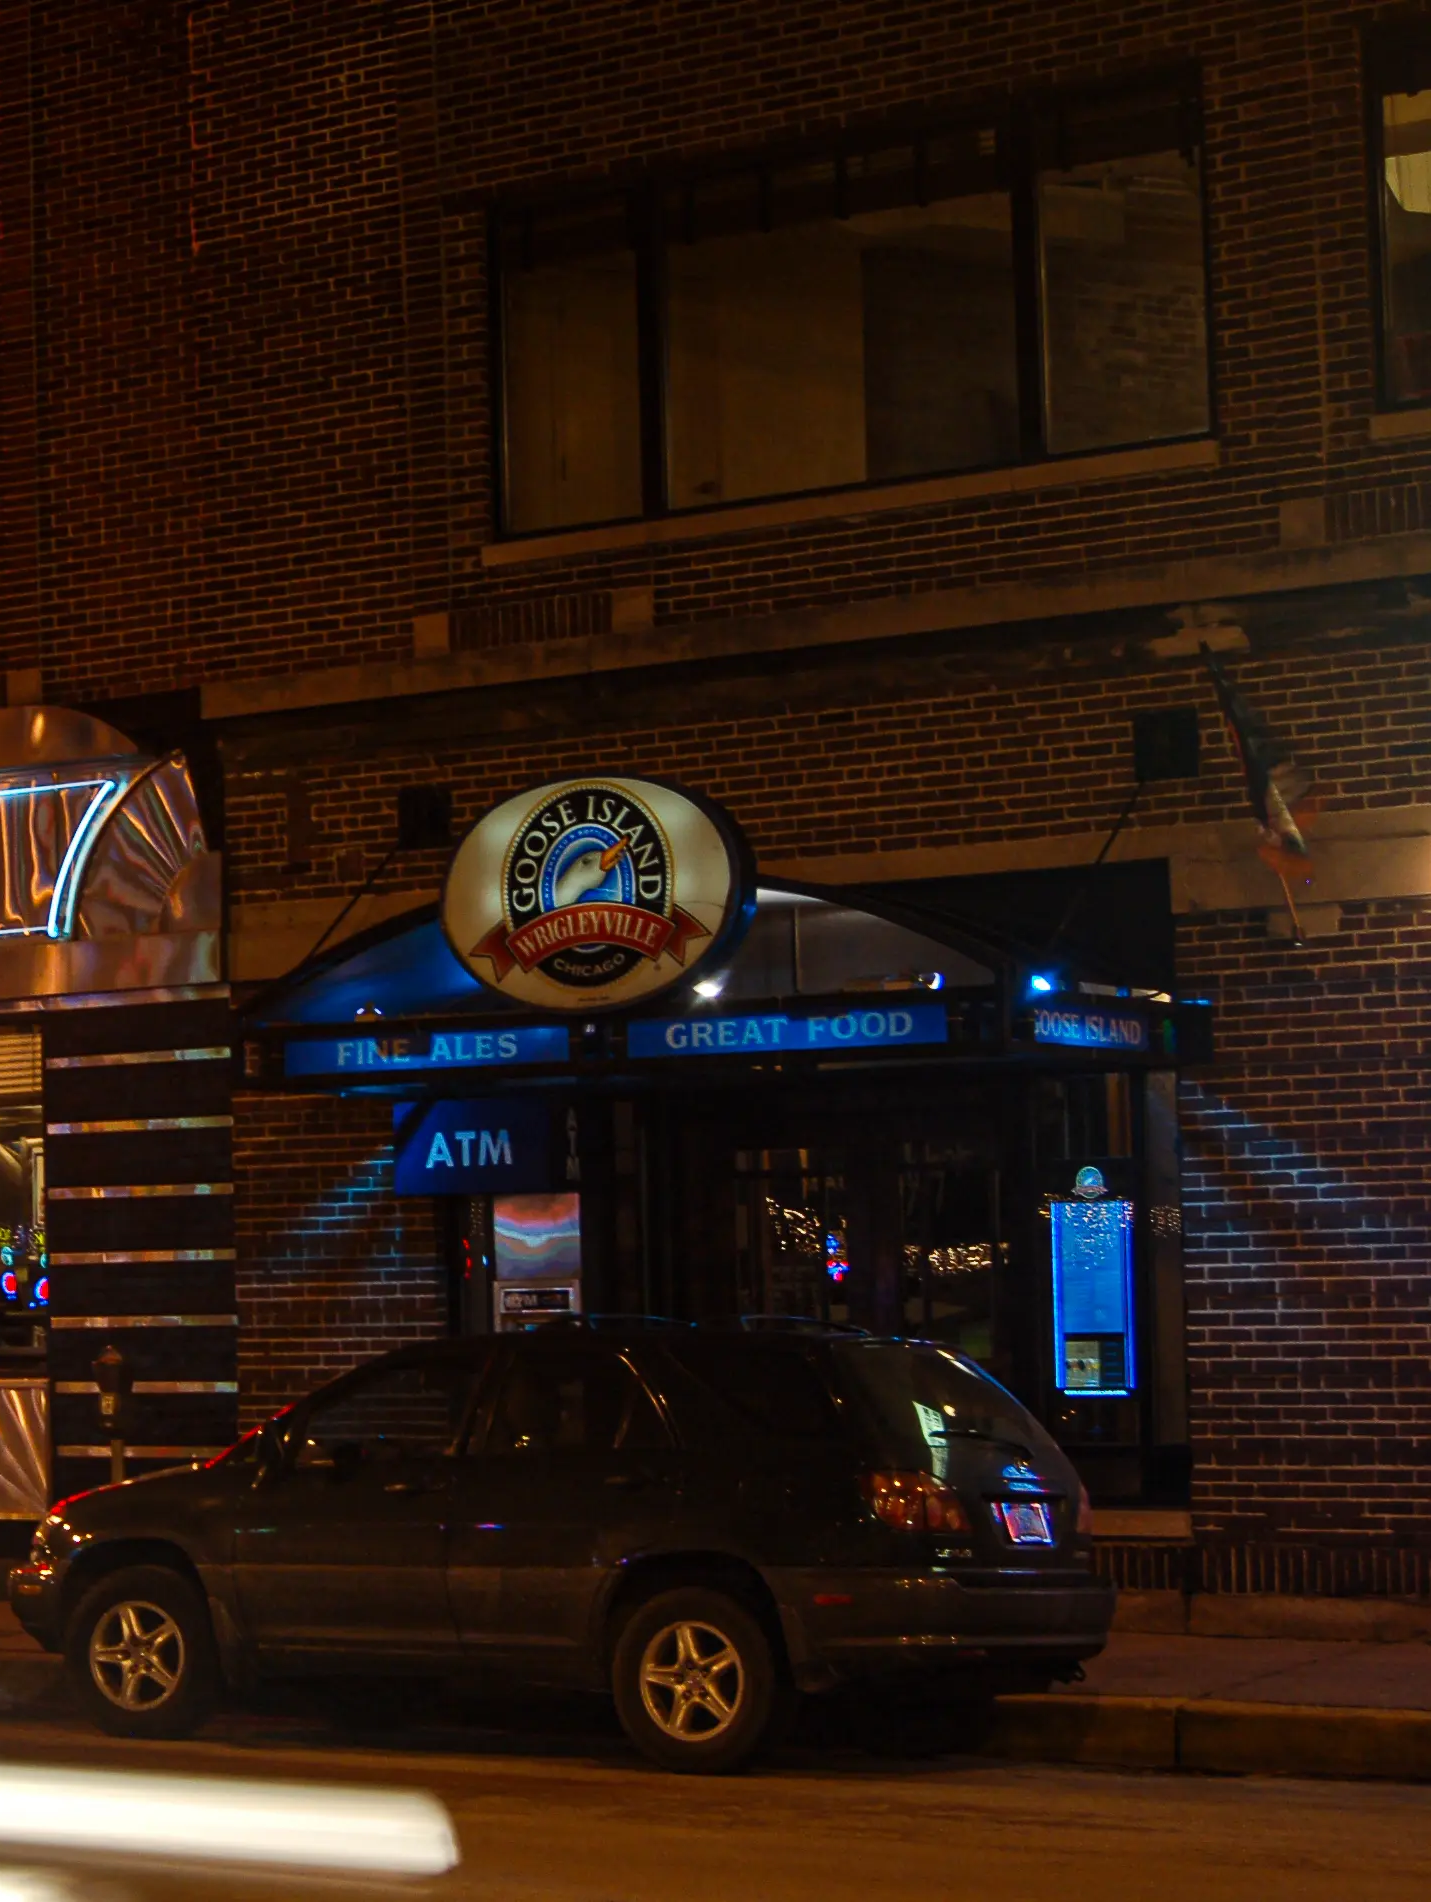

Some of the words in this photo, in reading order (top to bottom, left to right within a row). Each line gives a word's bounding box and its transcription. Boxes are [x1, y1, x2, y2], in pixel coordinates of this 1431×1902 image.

[512, 800, 577, 912] GOOSE
[586, 795, 662, 900] ISLAND
[516, 910, 662, 957] WRIGLEYVILLE
[553, 953, 625, 976] CHICAGO
[337, 1038, 410, 1066] FINE
[430, 1033, 518, 1062] ALES
[665, 1017, 788, 1050] GREAT
[807, 1011, 913, 1043] FOOD
[1085, 1016, 1141, 1045] ISLAND
[426, 1130, 513, 1169] ATM
